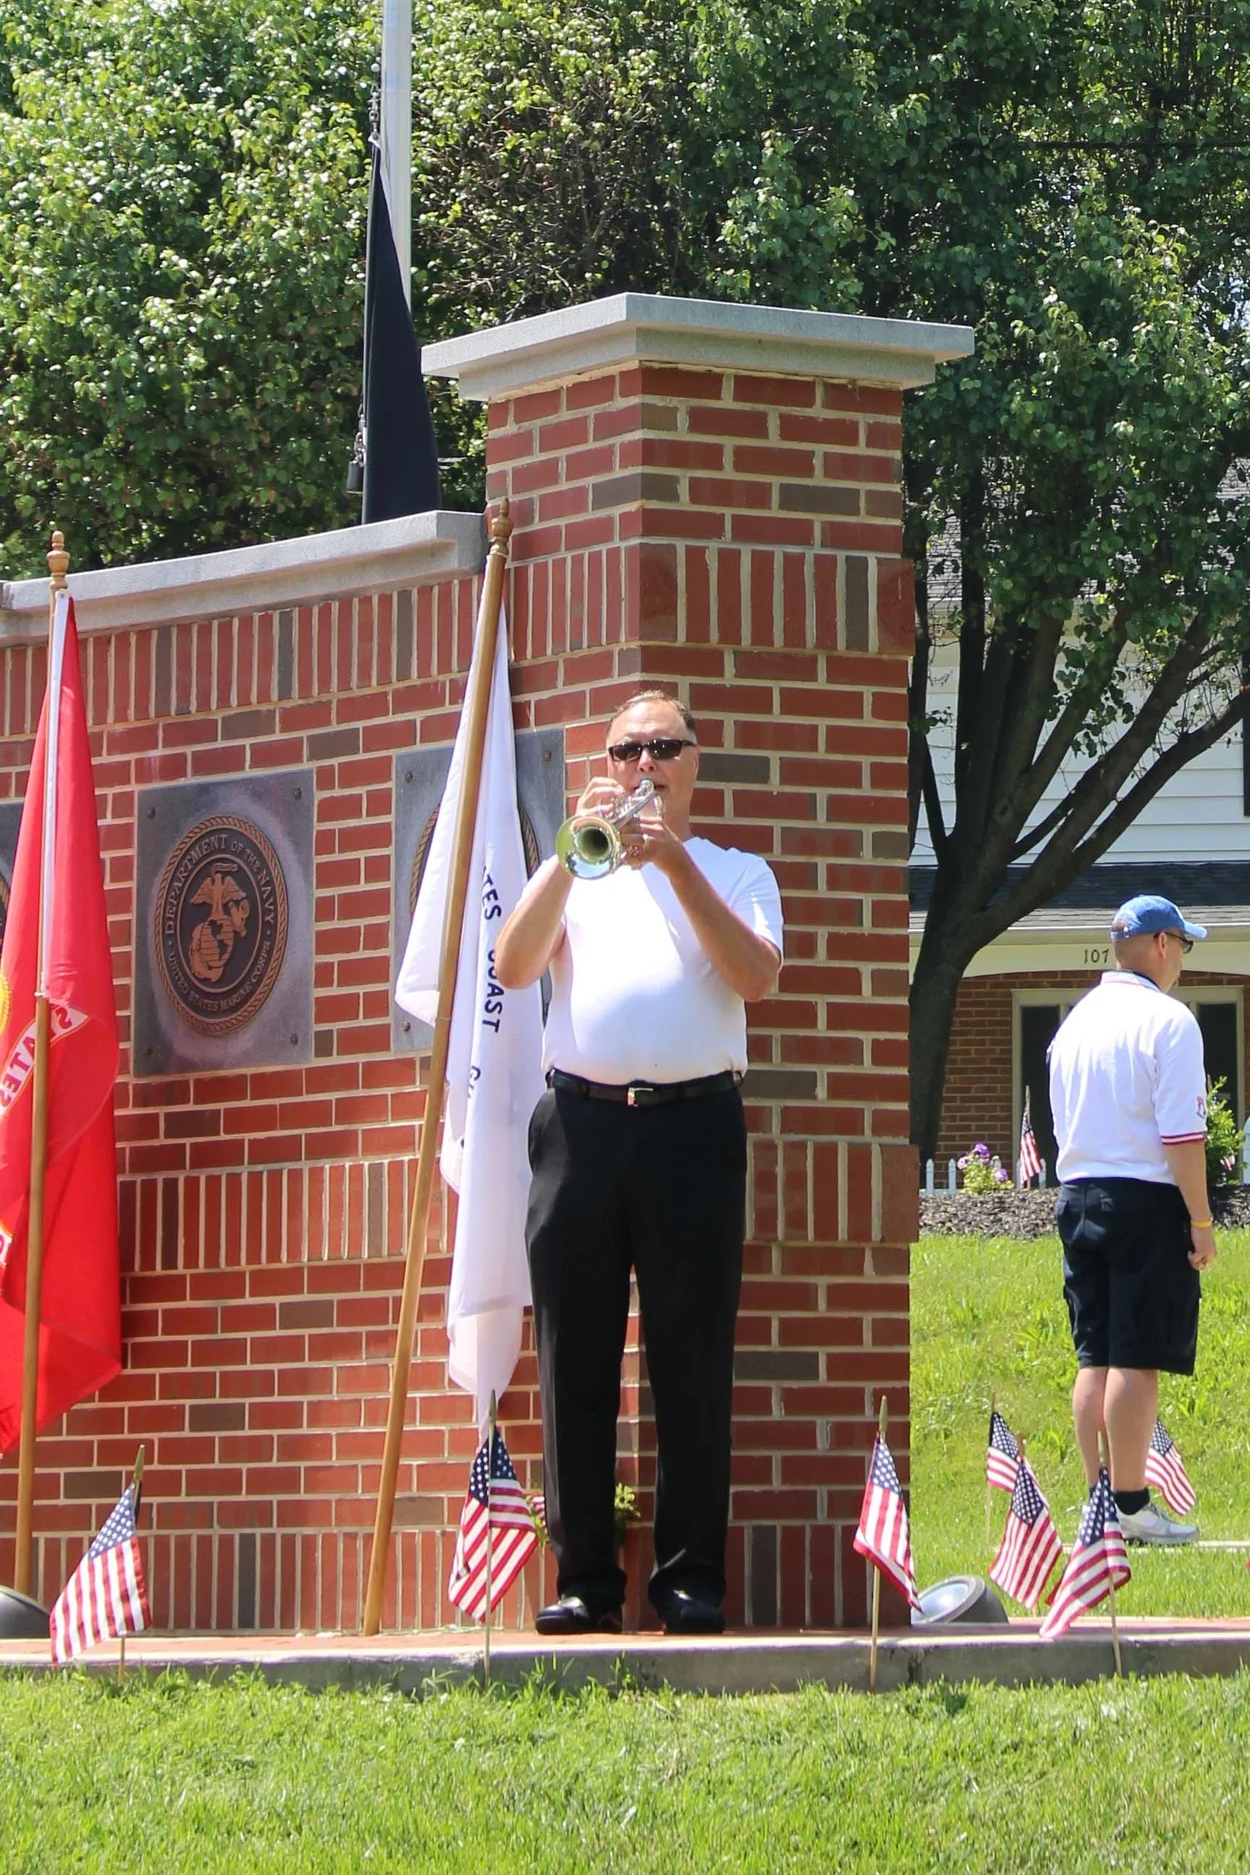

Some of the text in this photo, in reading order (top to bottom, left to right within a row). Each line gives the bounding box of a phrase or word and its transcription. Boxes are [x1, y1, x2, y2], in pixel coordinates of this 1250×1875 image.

[166, 834, 274, 934] DEPARTMENT OF THE NAVY
[250, 941, 271, 983] CORPS
[1084, 948, 1109, 964] 107
